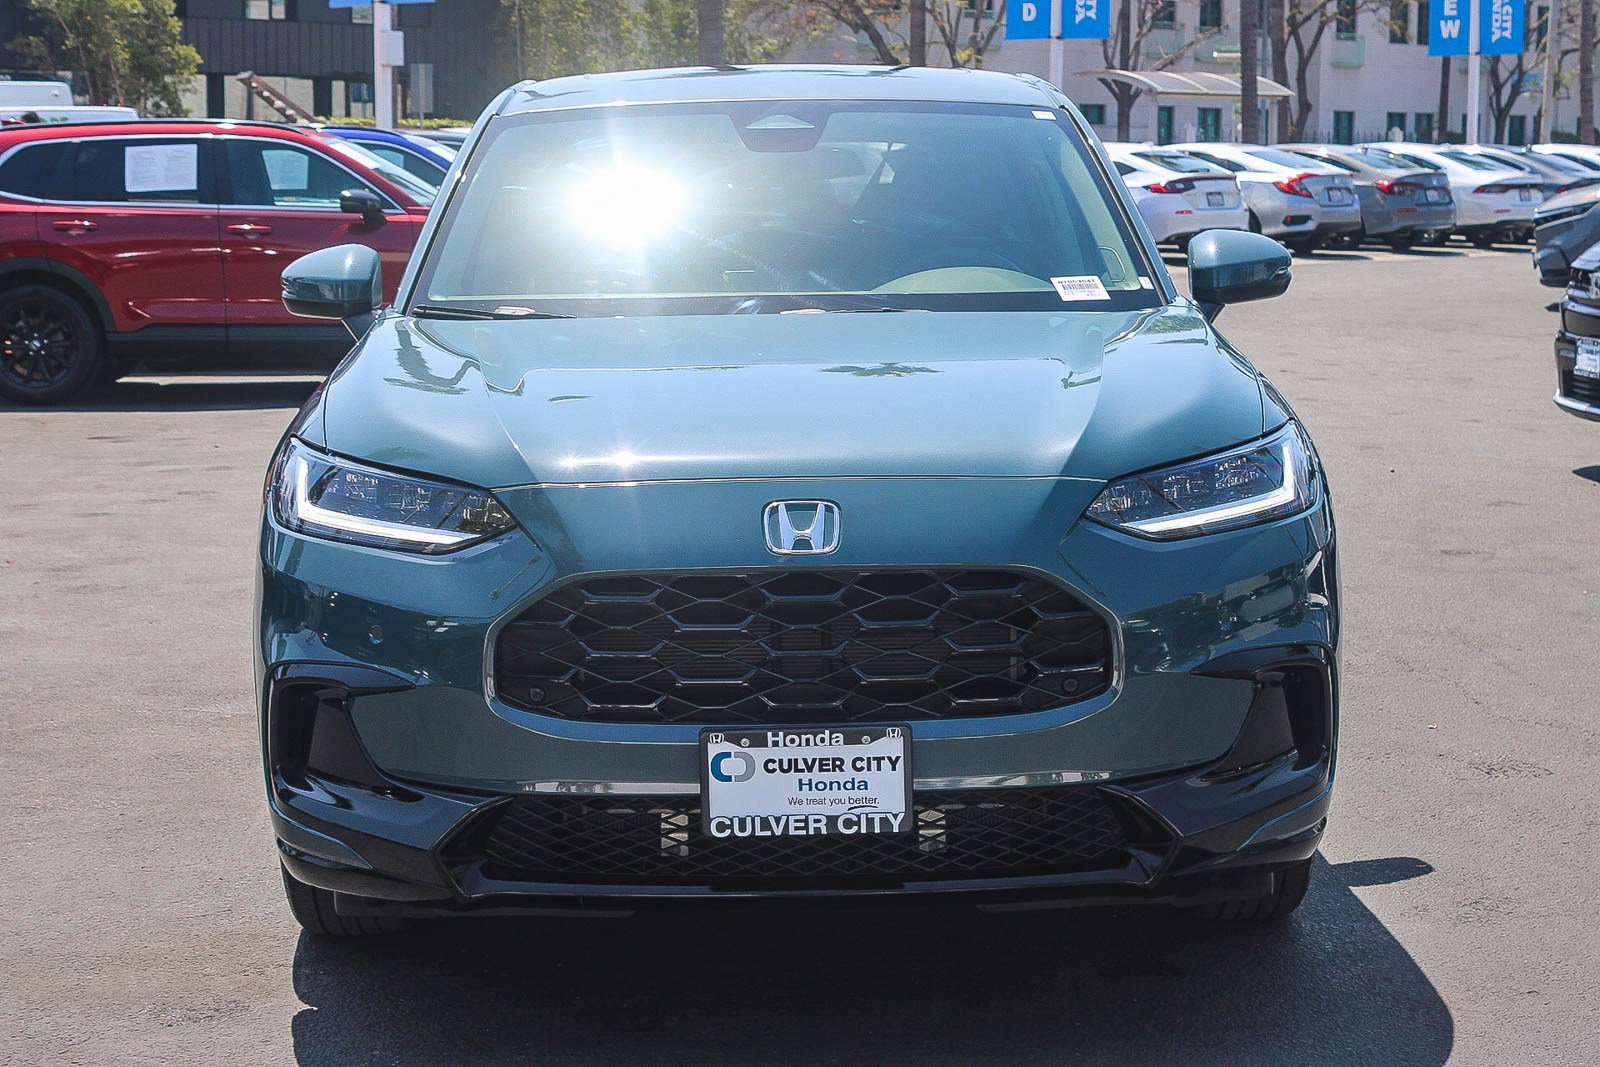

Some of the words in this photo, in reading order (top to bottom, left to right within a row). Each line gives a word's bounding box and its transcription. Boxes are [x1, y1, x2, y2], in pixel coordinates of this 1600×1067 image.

[1501, 4, 1513, 40] CITY
[766, 729, 845, 748] Honda
[762, 757, 846, 774] CULVER
[850, 755, 902, 772] CITY
[798, 777, 869, 792] Honda
[787, 797, 804, 806] We
[805, 797, 827, 806] treat
[828, 798, 846, 808] you
[710, 814, 827, 838] CULVER
[837, 812, 905, 835] CITY
